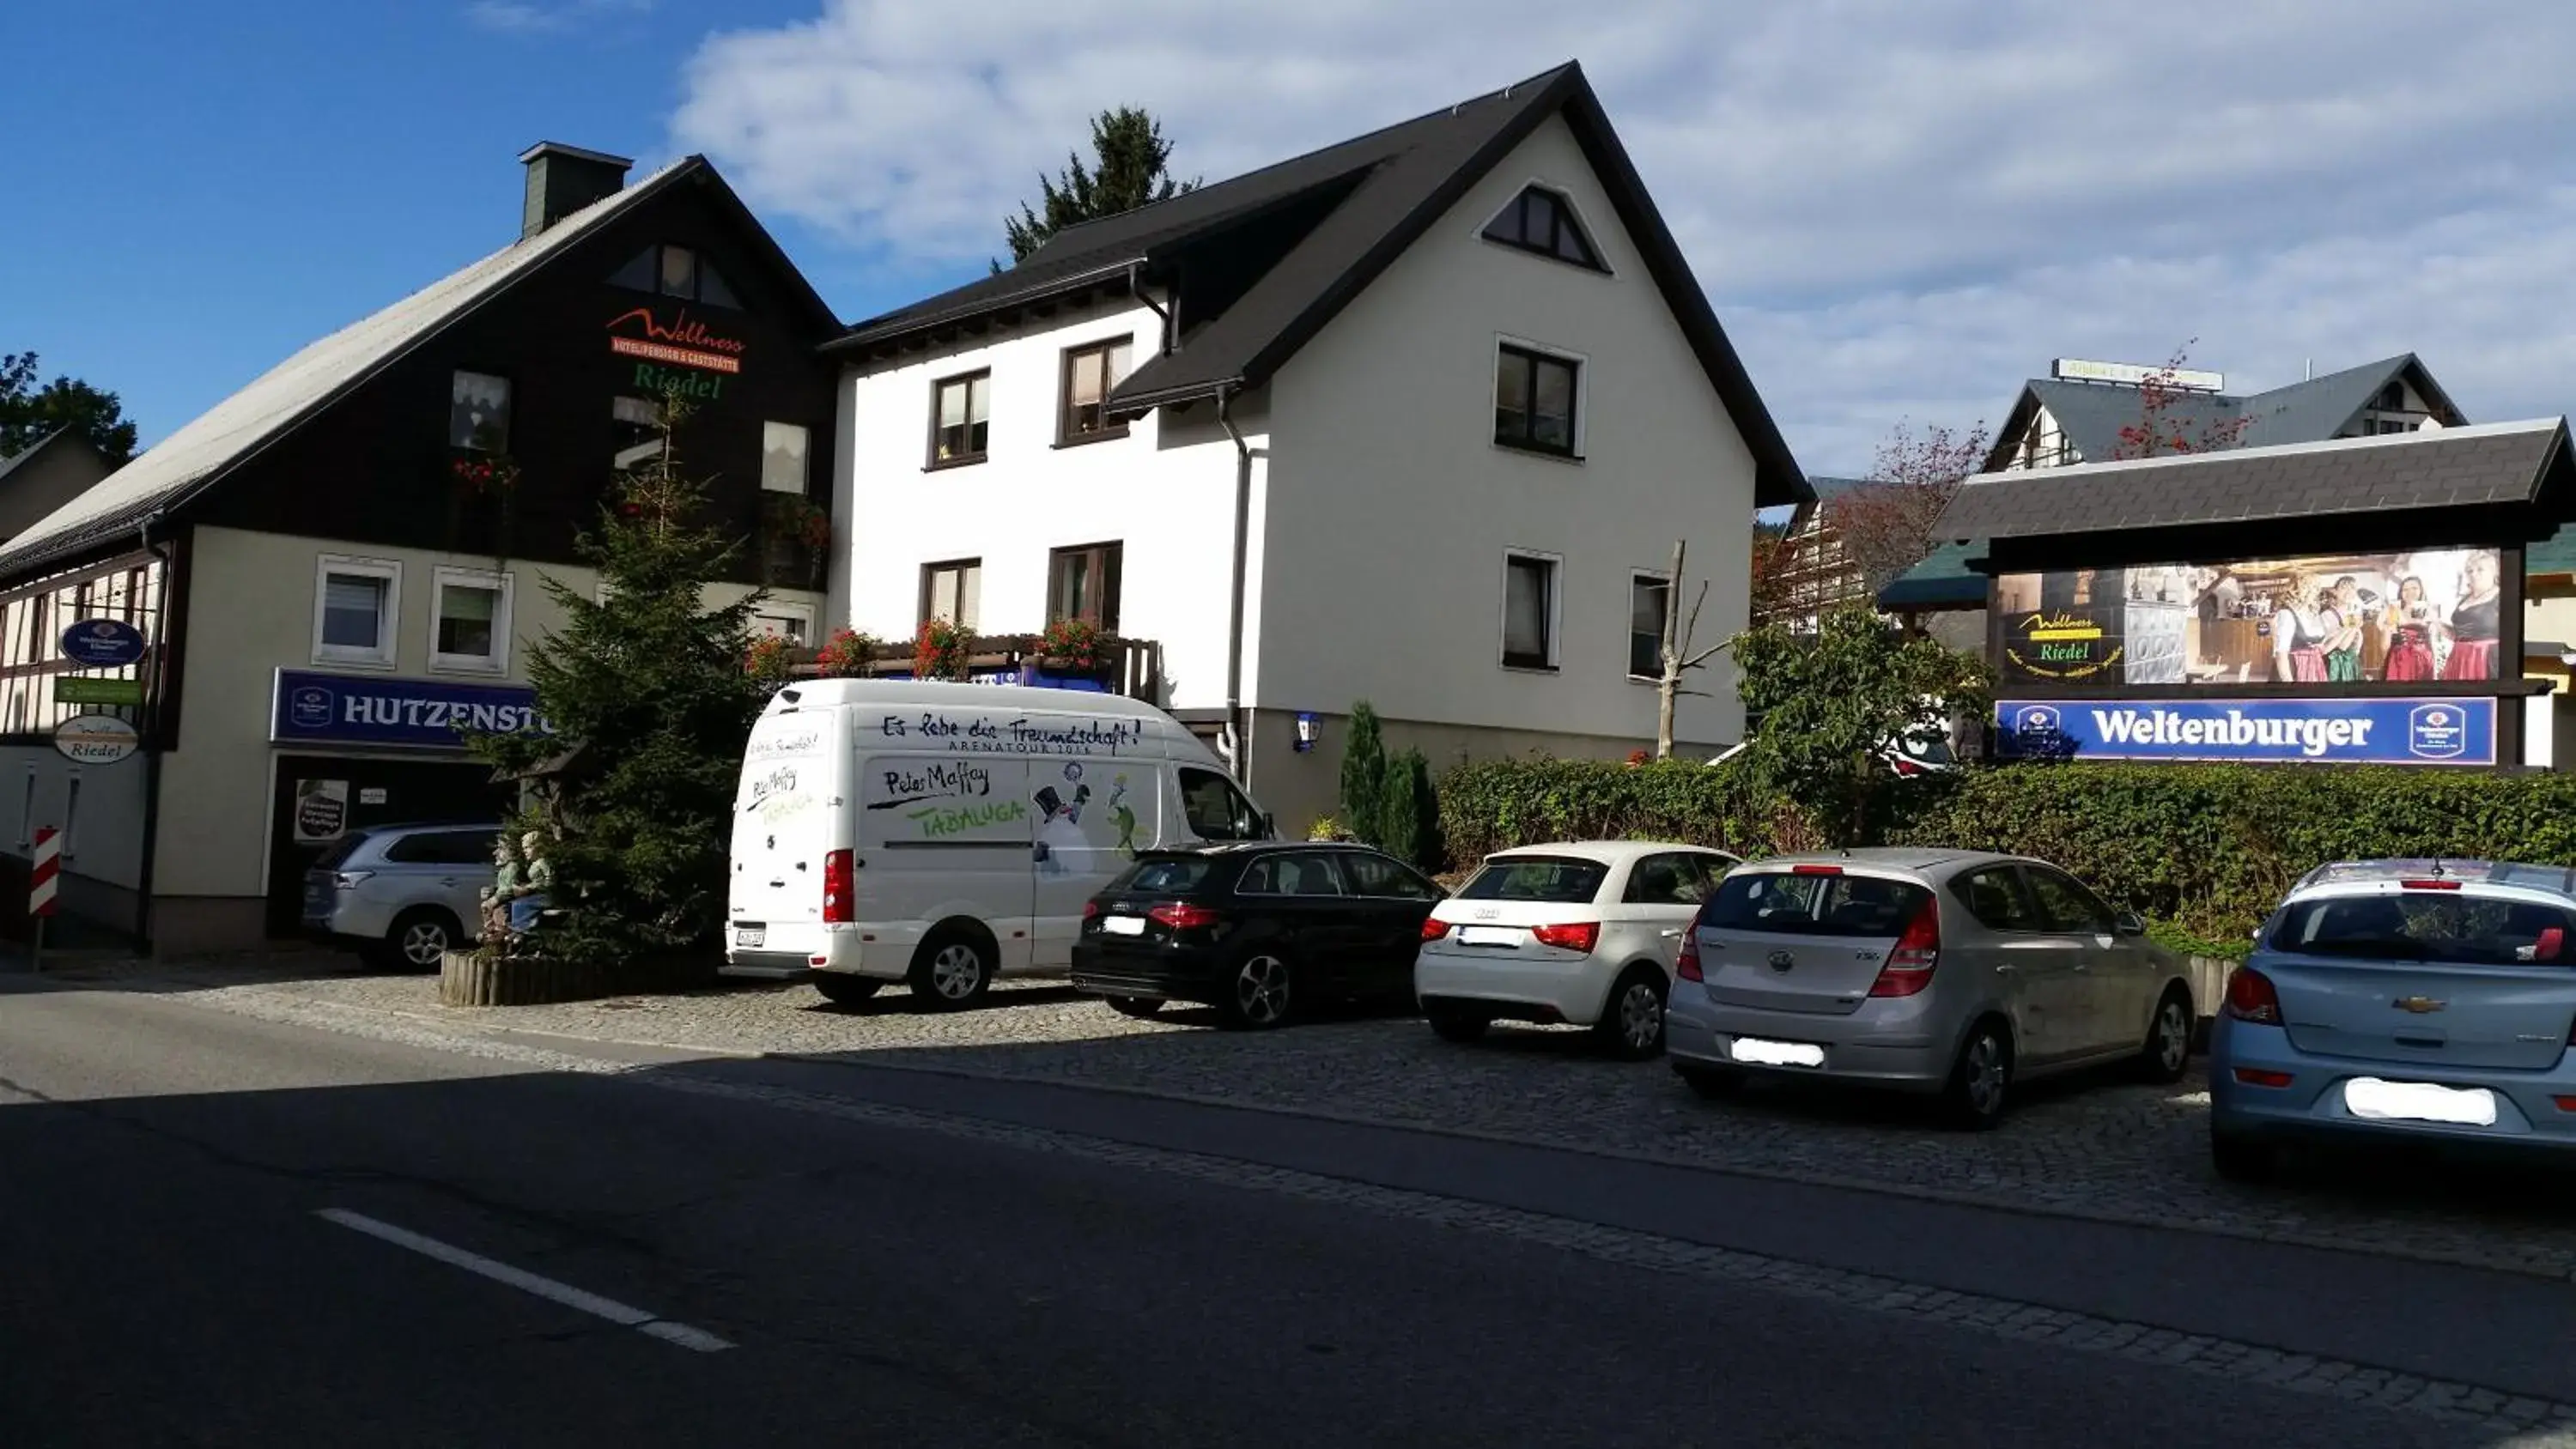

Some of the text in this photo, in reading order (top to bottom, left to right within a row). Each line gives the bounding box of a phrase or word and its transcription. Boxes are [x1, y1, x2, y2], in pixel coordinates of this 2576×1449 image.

[606, 307, 746, 353] Wellness
[635, 363, 721, 399] Riedel
[2019, 608, 2093, 629] Wellness
[2040, 642, 2089, 660] Riedel
[882, 716, 905, 736] Es
[919, 712, 958, 737] lebe
[969, 717, 997, 738] die
[2092, 710, 2373, 756] Weltenburger
[71, 743, 121, 757] Riedel
[927, 762, 989, 796] Maffay
[907, 800, 1025, 837] TABALUGA
